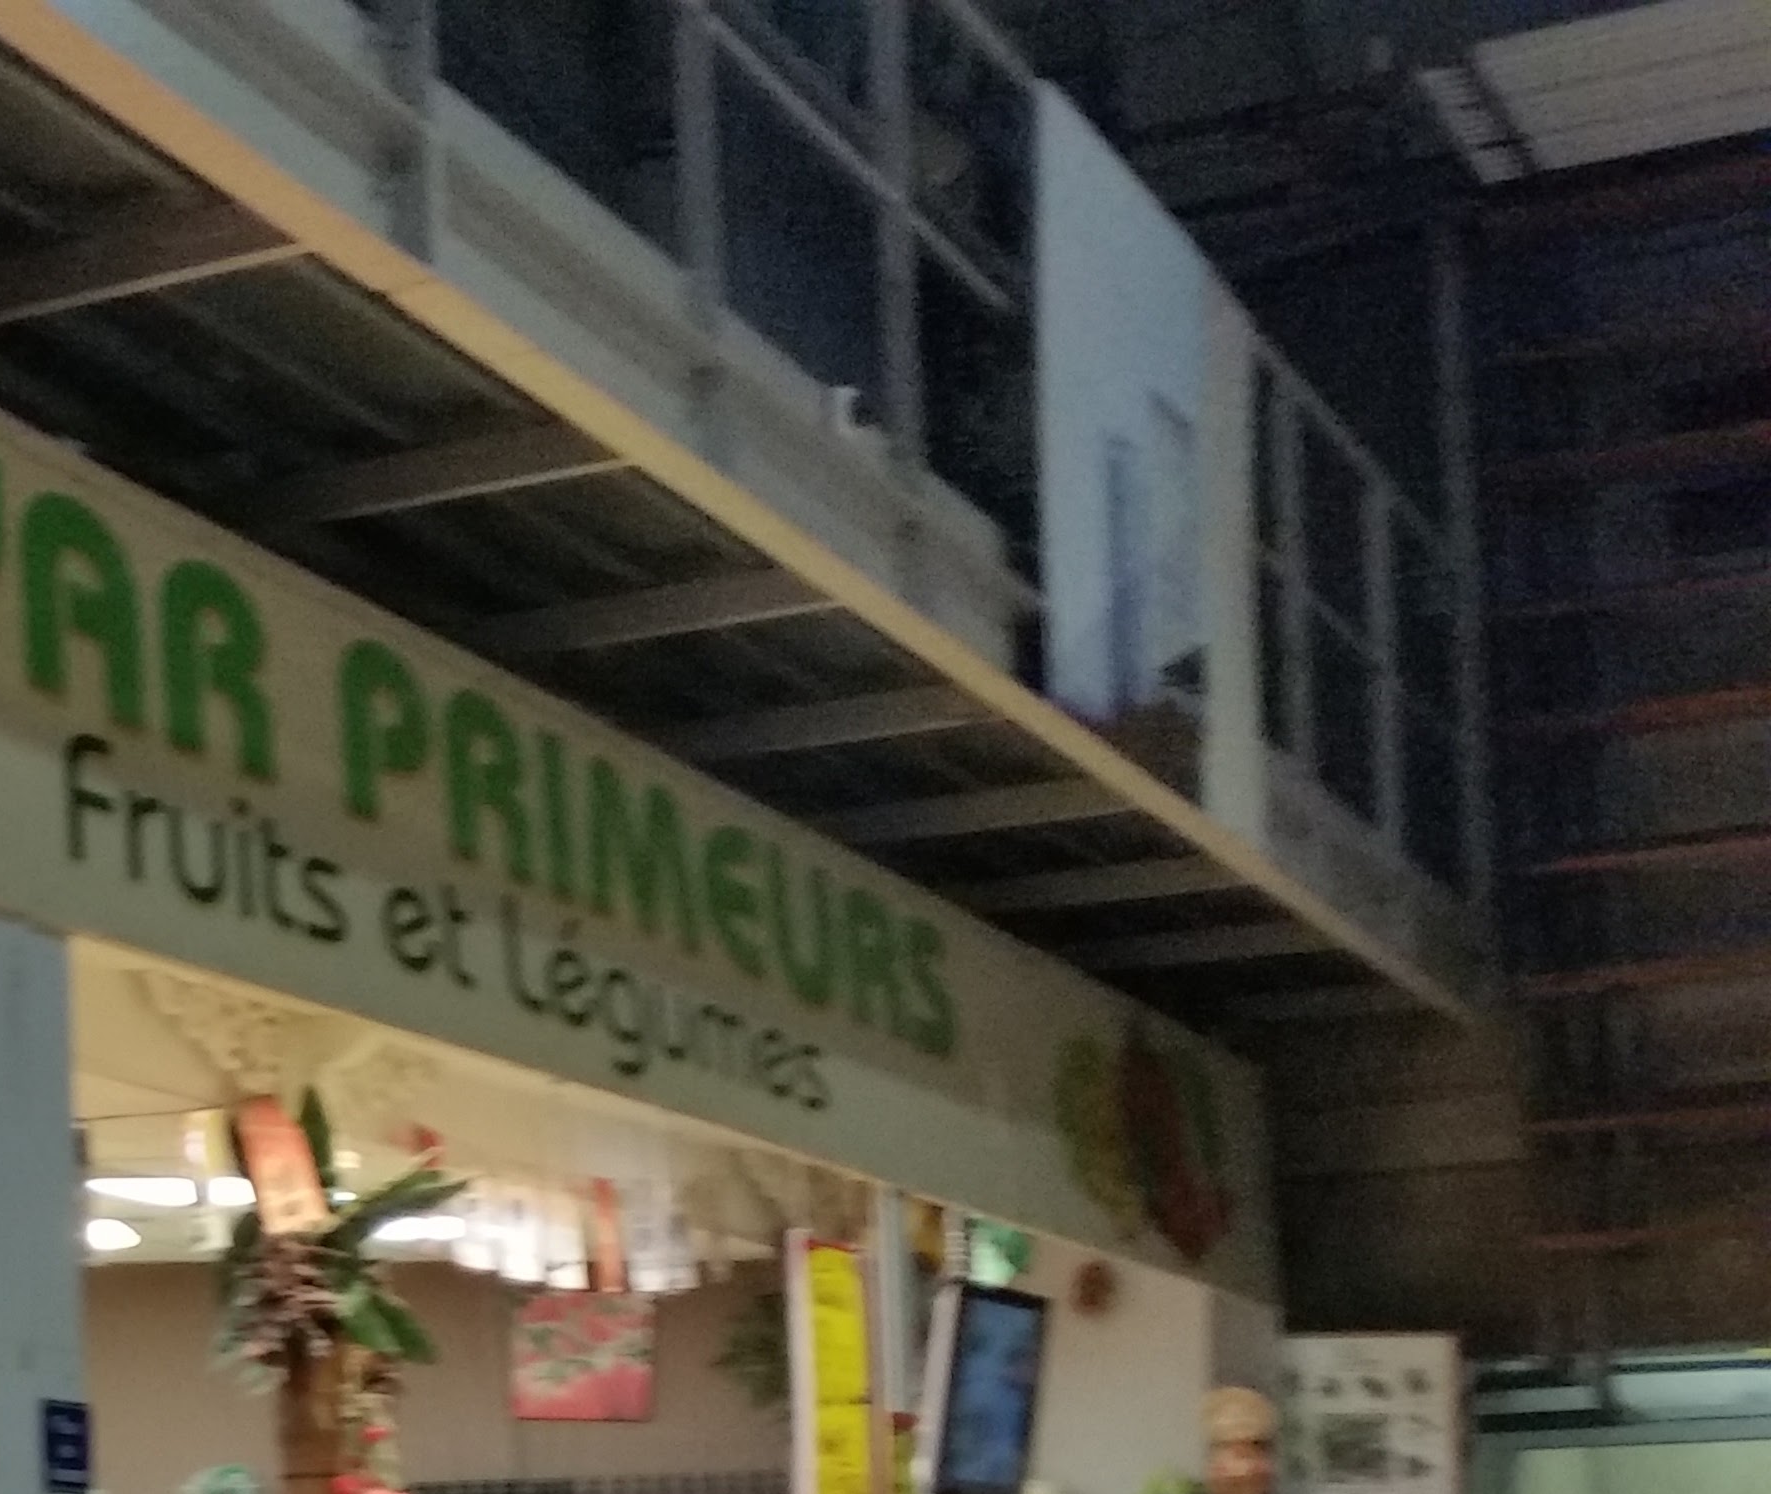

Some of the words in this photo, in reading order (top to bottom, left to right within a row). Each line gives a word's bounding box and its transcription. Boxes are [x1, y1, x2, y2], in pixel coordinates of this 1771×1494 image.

[64, 732, 349, 943] Fruits
[382, 887, 475, 990] et
[339, 638, 953, 1058] PRIMEURS
